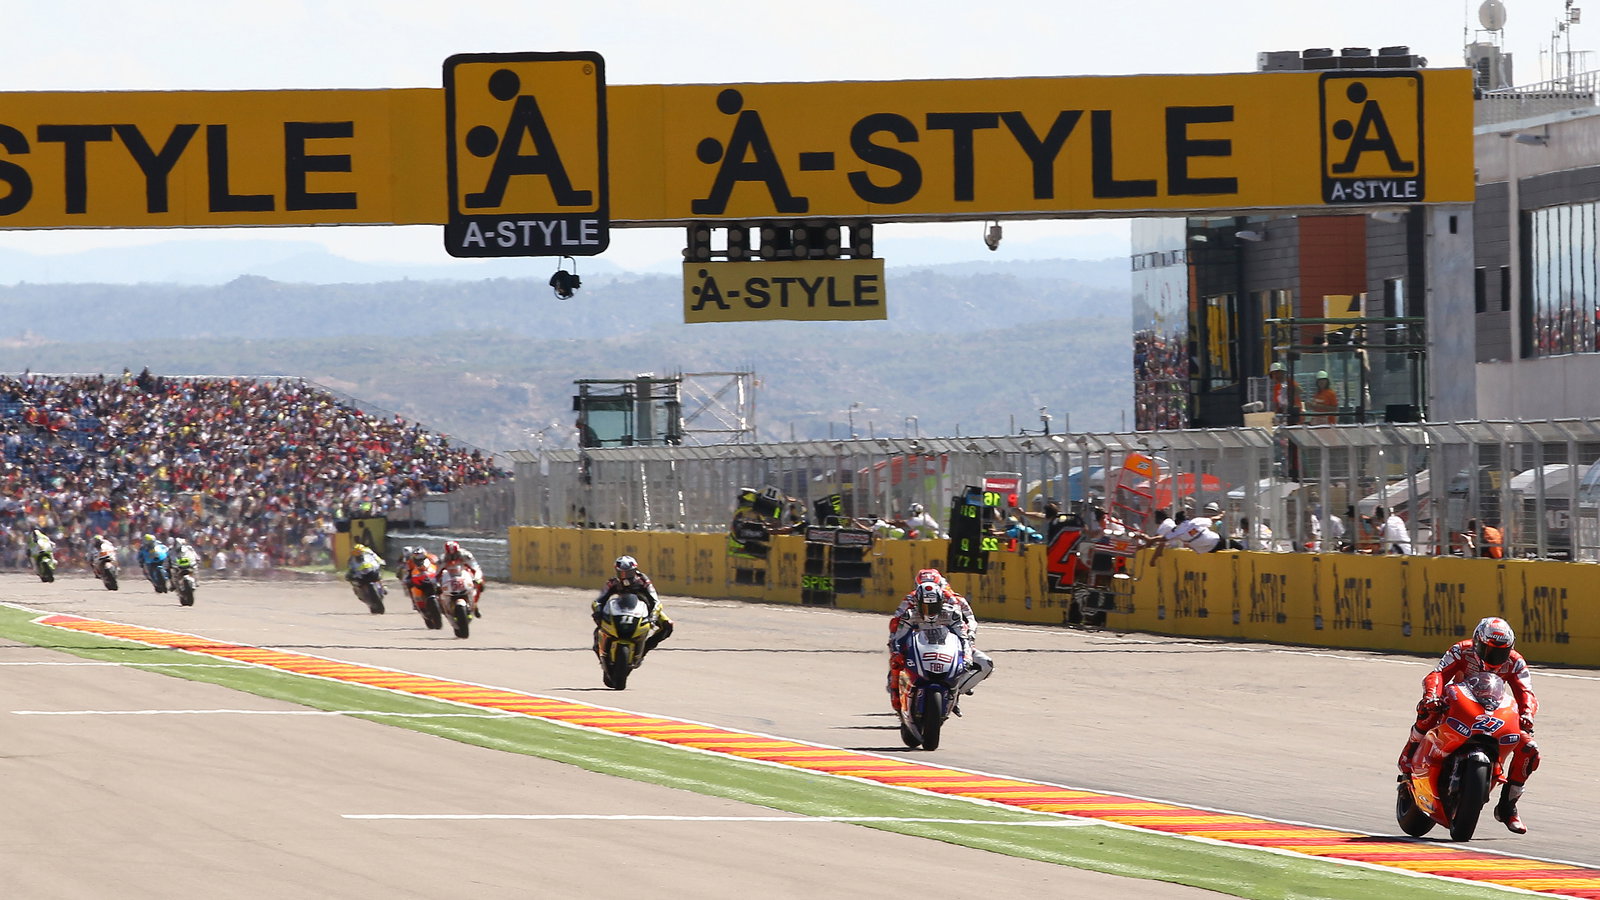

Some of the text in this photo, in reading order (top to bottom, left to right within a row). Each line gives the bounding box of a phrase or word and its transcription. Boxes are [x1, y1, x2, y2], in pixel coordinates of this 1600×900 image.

[691, 105, 1238, 215] A-STYLE
[1331, 180, 1417, 201] A-STYLE
[462, 218, 600, 249] A-STYLE
[691, 273, 879, 311] A-STYLE
[1521, 569, 1570, 644] A-STYLE
[1456, 724, 1470, 735] TIM
